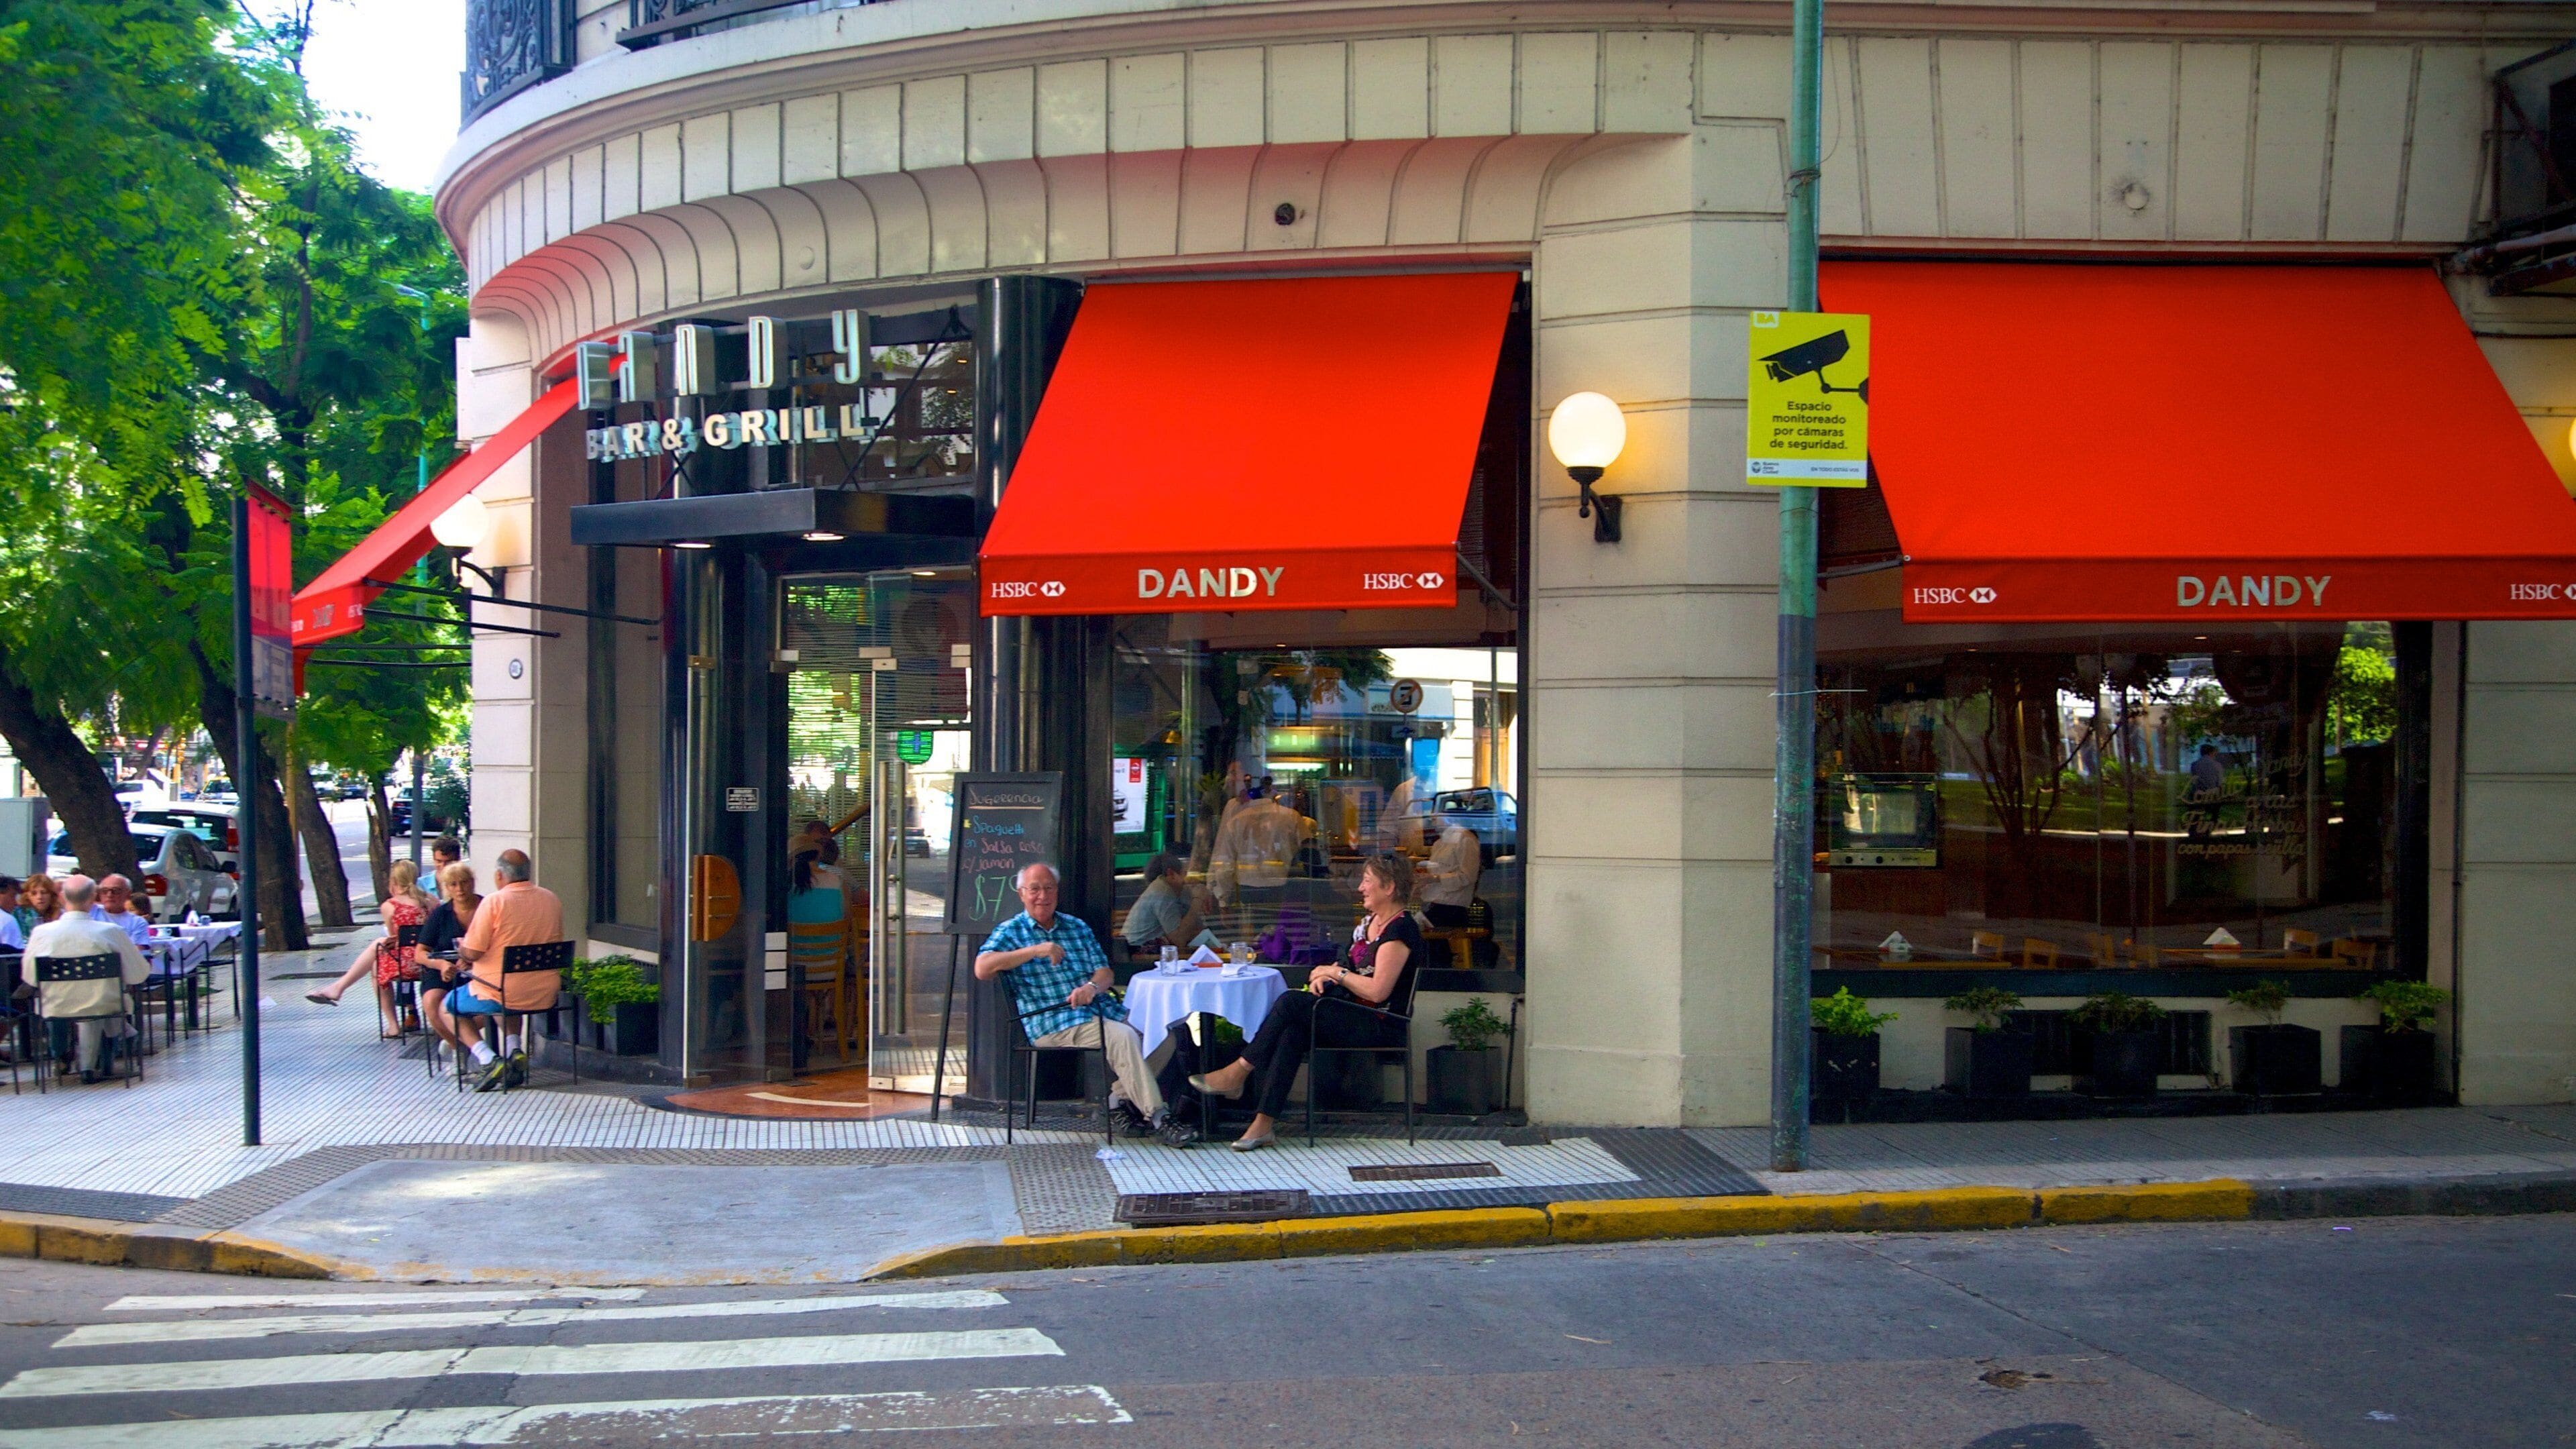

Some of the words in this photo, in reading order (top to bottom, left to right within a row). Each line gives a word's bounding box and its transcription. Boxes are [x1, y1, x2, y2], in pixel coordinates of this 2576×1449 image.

[1787, 401, 1832, 411] Espacio
[704, 405, 868, 448] GRILL
[1772, 415, 1846, 424] monitoreado
[1774, 427, 1794, 437] por
[1797, 427, 1844, 437] cámaras
[1770, 439, 1784, 448] de
[1788, 440, 1847, 450] seguridad.
[991, 582, 1038, 598] HSBC
[1138, 567, 1285, 598] DANDY
[1364, 574, 1413, 590] HSBC
[1914, 588, 1966, 604] HSBC
[2178, 576, 2332, 607] DANDY
[2511, 584, 2562, 600] HSBC
